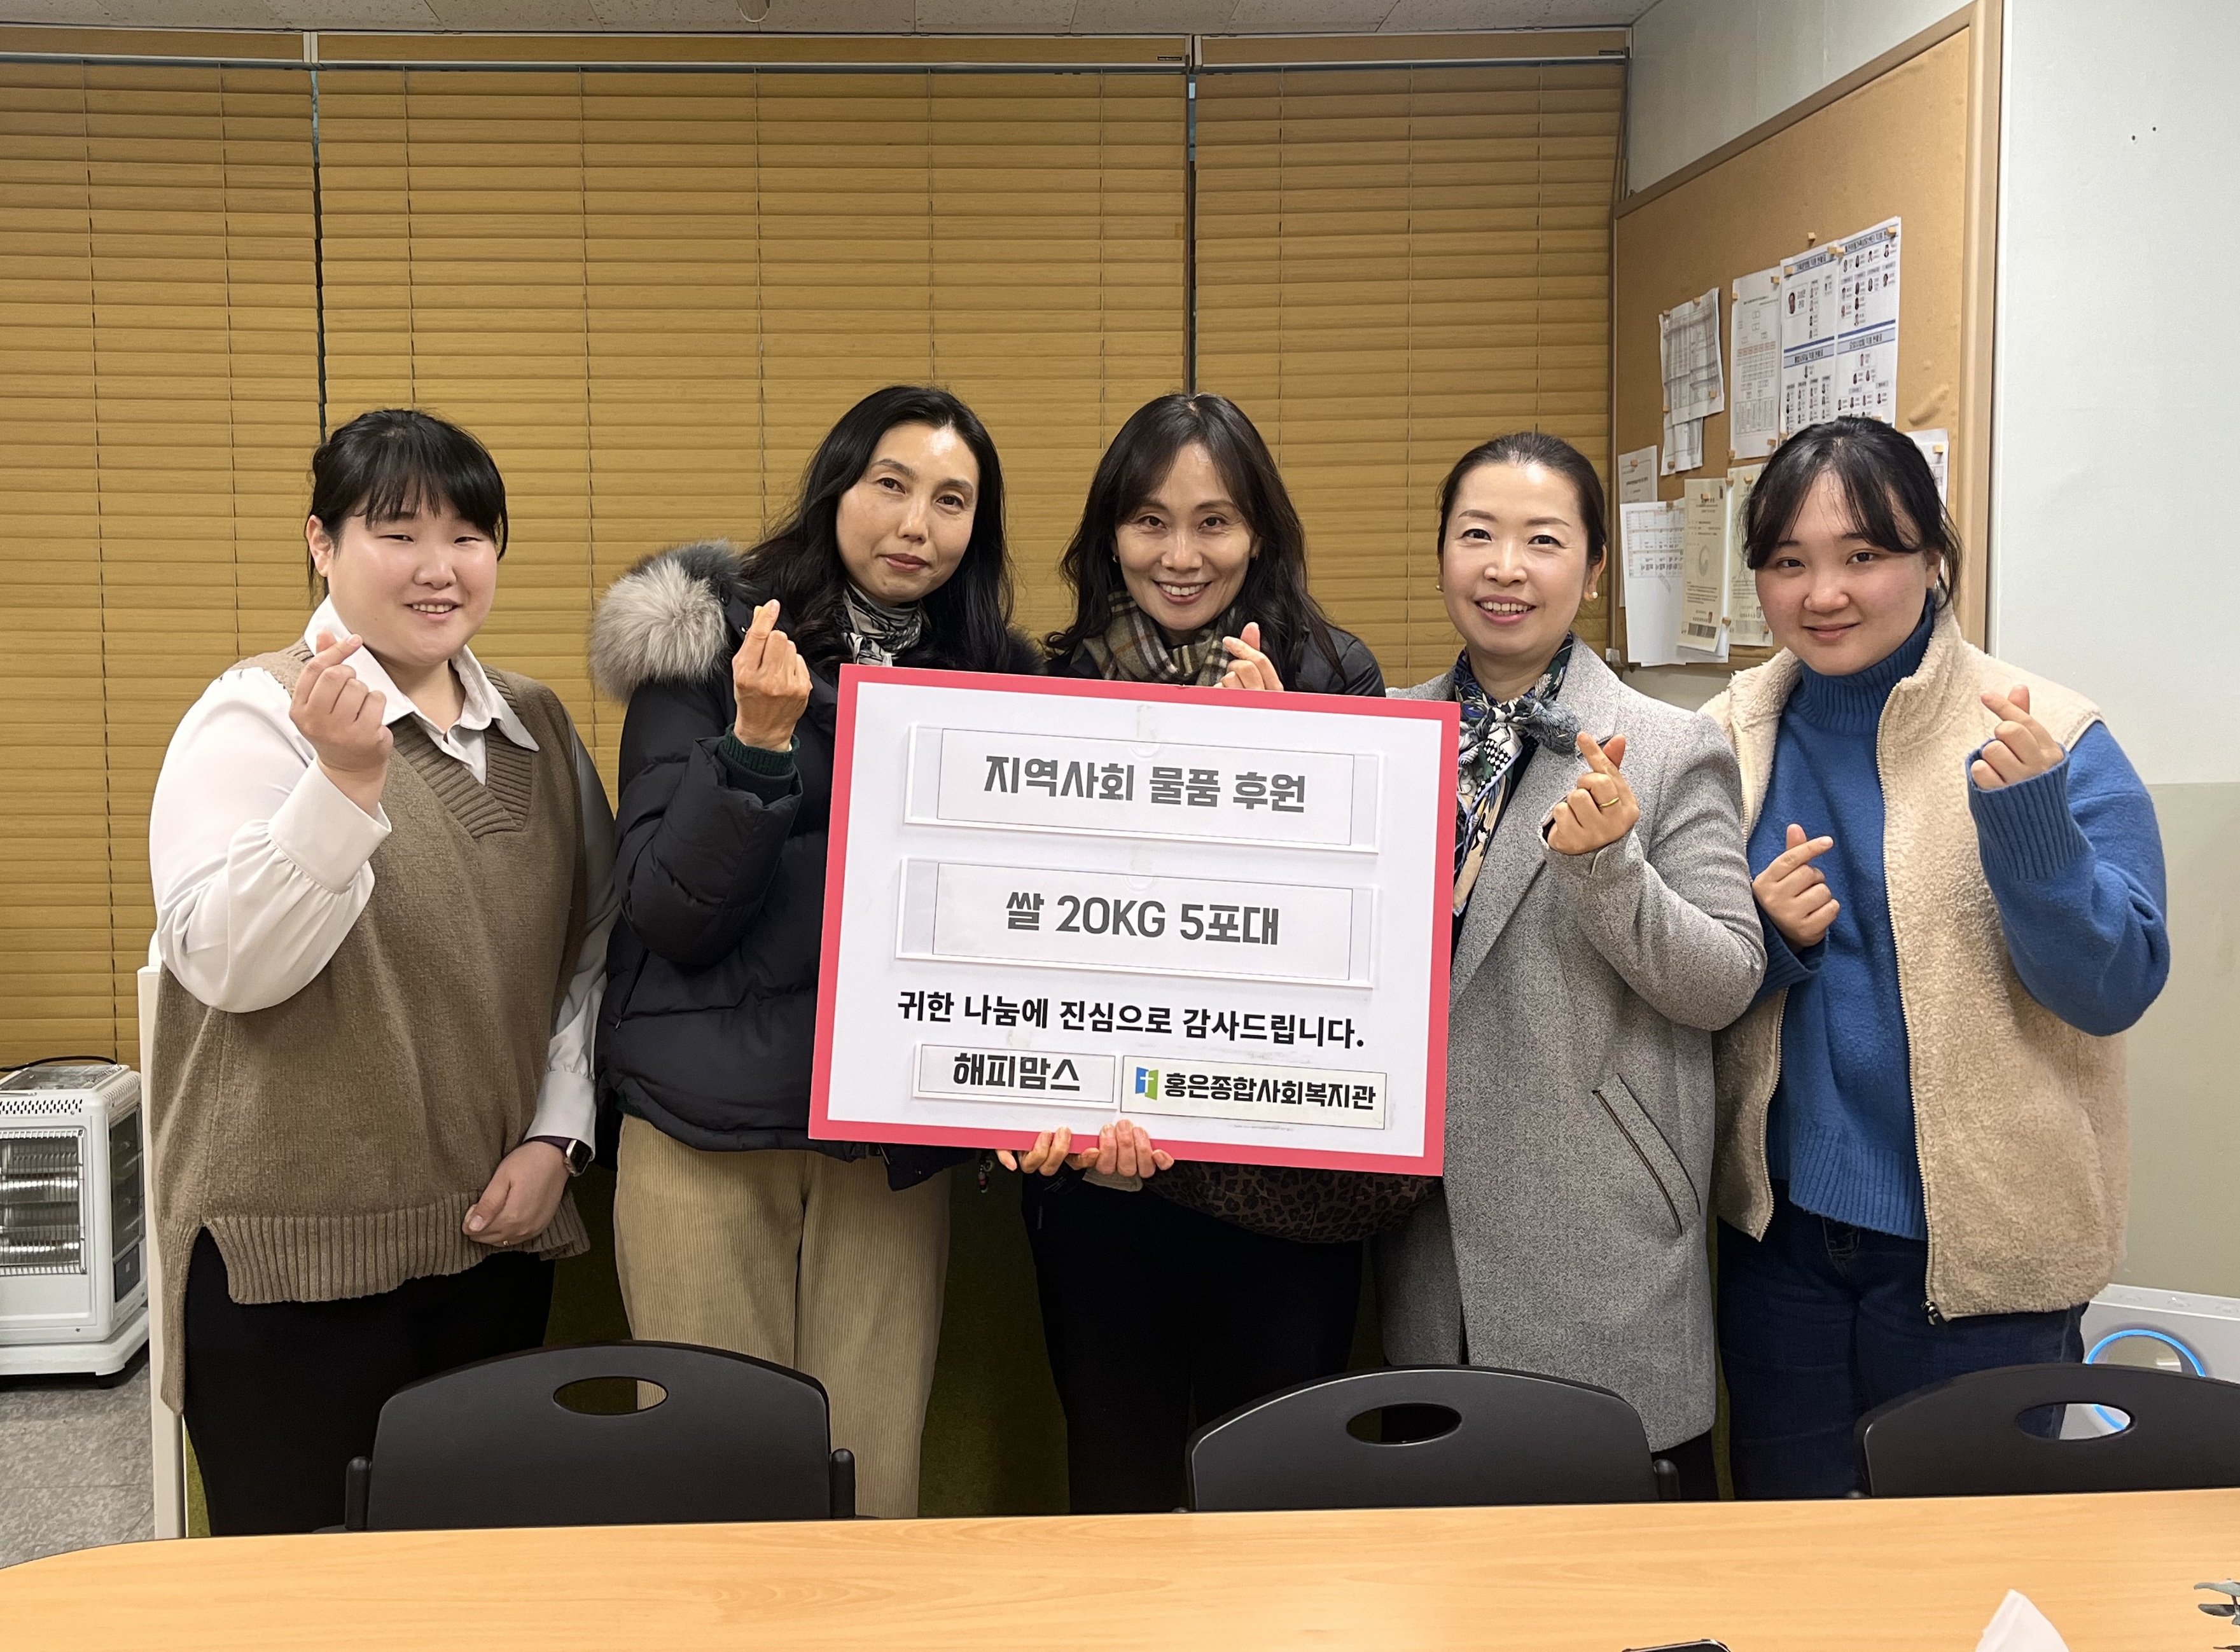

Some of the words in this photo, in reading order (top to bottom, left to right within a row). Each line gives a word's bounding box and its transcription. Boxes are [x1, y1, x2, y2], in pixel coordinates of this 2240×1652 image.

[984, 756, 1134, 801] 지역사회
[1149, 767, 1220, 807] 물품
[1233, 772, 1305, 813] 후원
[1006, 892, 1045, 931] 쌀
[1055, 895, 1165, 938] 20KG
[1180, 903, 1279, 945] 5포대
[898, 990, 955, 1023] 귀한
[964, 994, 1048, 1029] 나눔에
[1059, 1001, 1172, 1034] 진심으로
[1183, 1008, 1364, 1049] 감사드립니다.
[953, 1053, 1080, 1092] 해피맘스
[1164, 1072, 1376, 1111] 홍은종합사회복지관
